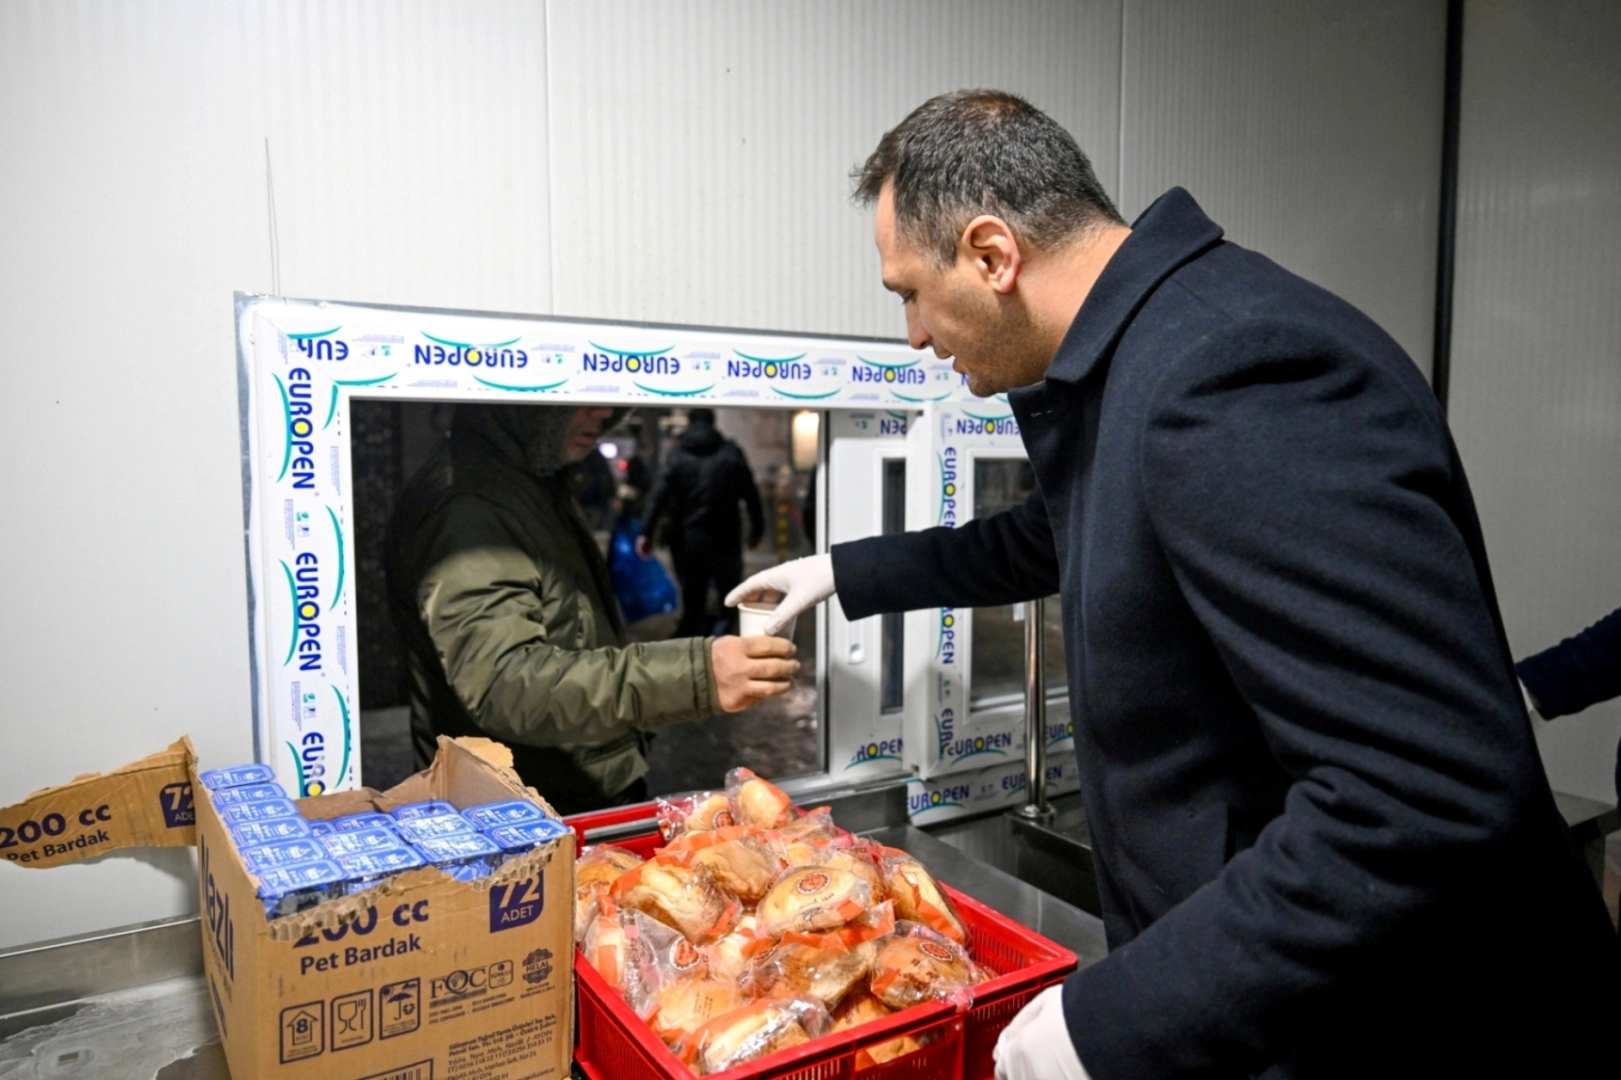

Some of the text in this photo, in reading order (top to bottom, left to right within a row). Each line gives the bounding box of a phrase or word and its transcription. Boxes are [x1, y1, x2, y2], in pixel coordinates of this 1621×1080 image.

[414, 344, 528, 368] EUROPEN
[583, 353, 680, 375] EUROPEN
[727, 359, 811, 380] EUROPEN
[852, 366, 926, 385] EUROPEN
[289, 368, 315, 489] EUROPEN
[296, 552, 321, 671] EUROPEN
[302, 732, 326, 797] EURO
[0, 804, 112, 848] 200 cc
[175, 812, 195, 821] ADE
[43, 829, 110, 858] Bardak
[498, 873, 540, 909] 72
[393, 899, 429, 927] cc
[501, 905, 534, 923] ADET
[300, 933, 422, 976] Pet Bardak
[526, 960, 550, 973] HELAL
[430, 968, 487, 999] FQC
[295, 1018, 309, 1034] 8
